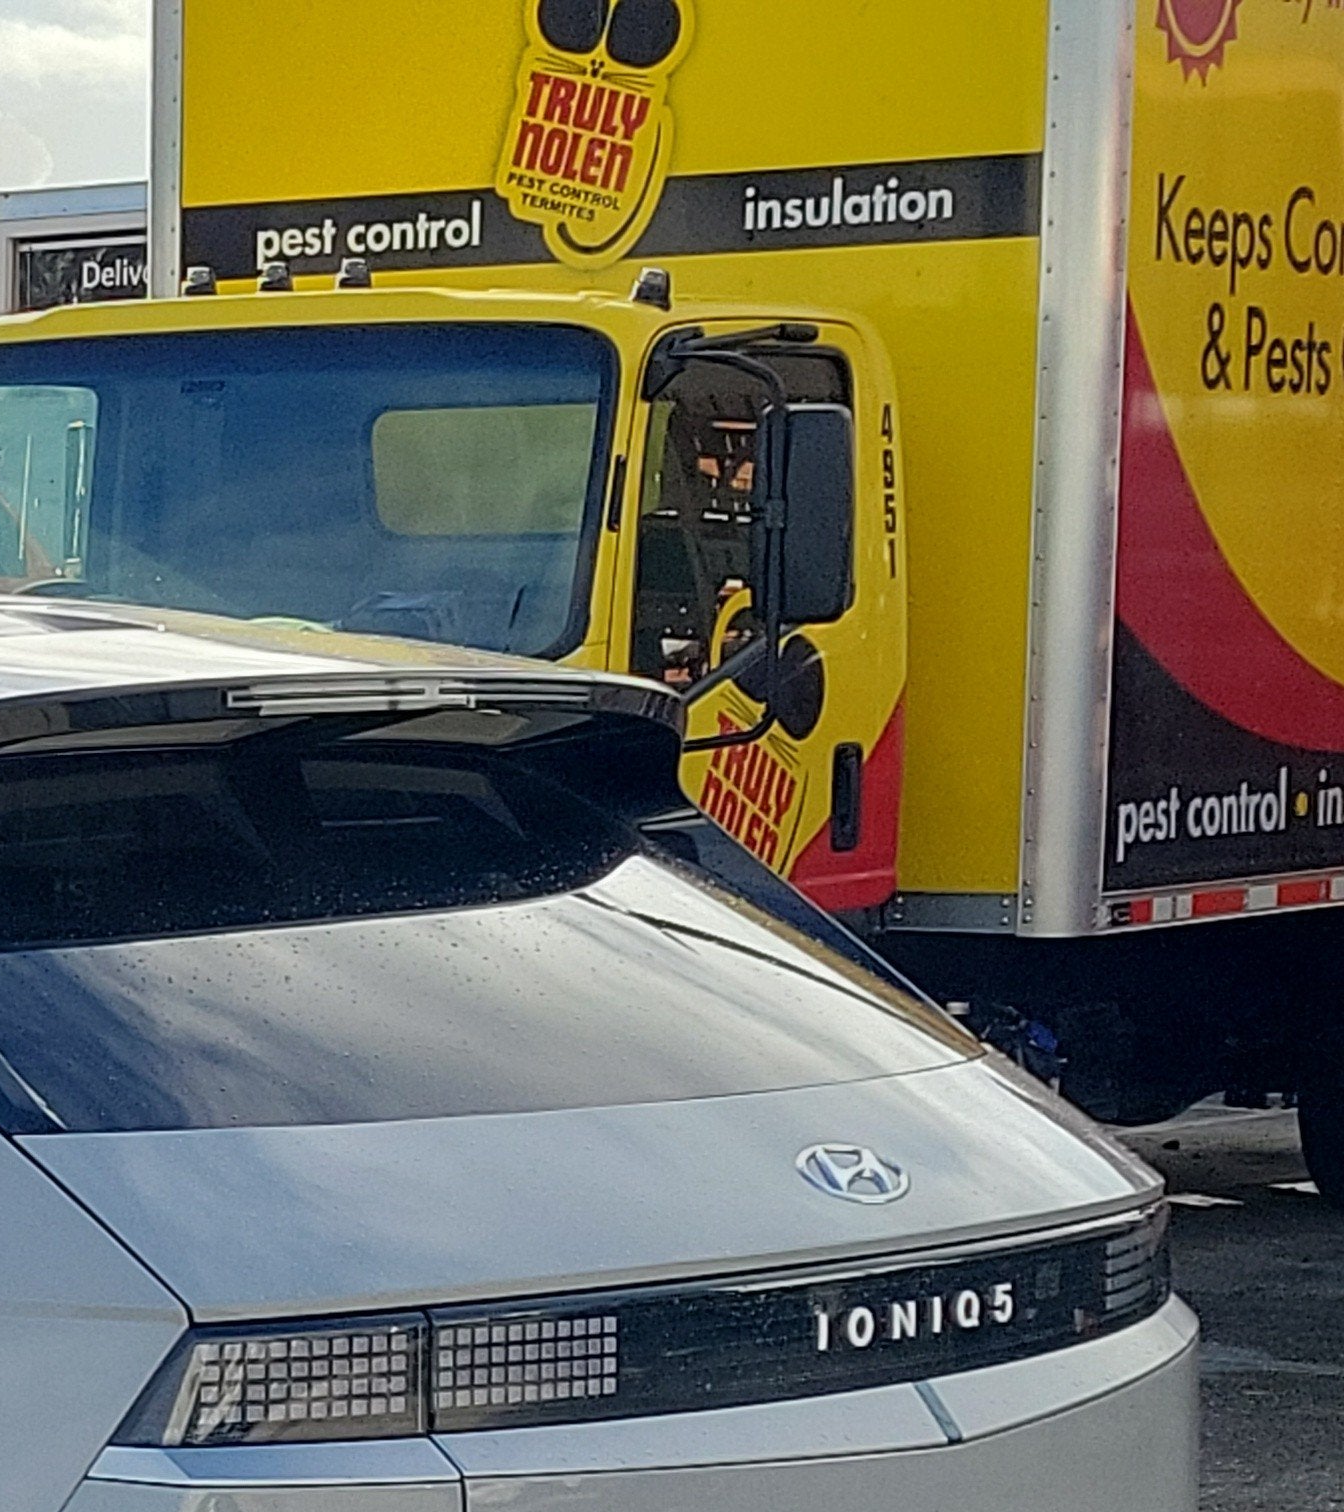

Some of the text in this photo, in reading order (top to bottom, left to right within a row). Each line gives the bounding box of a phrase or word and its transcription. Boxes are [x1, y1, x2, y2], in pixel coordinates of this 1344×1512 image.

[525, 71, 651, 141] TRULY
[507, 171, 621, 211] PEST CONTROL
[521, 192, 596, 222] TERMITES
[743, 176, 954, 231] insulation
[256, 200, 481, 271] pest control
[1155, 172, 1273, 296] Keeps
[1201, 301, 1332, 396] & Pests
[881, 403, 897, 580] 4951
[1115, 786, 1181, 863] pest
[1186, 766, 1289, 838] control
